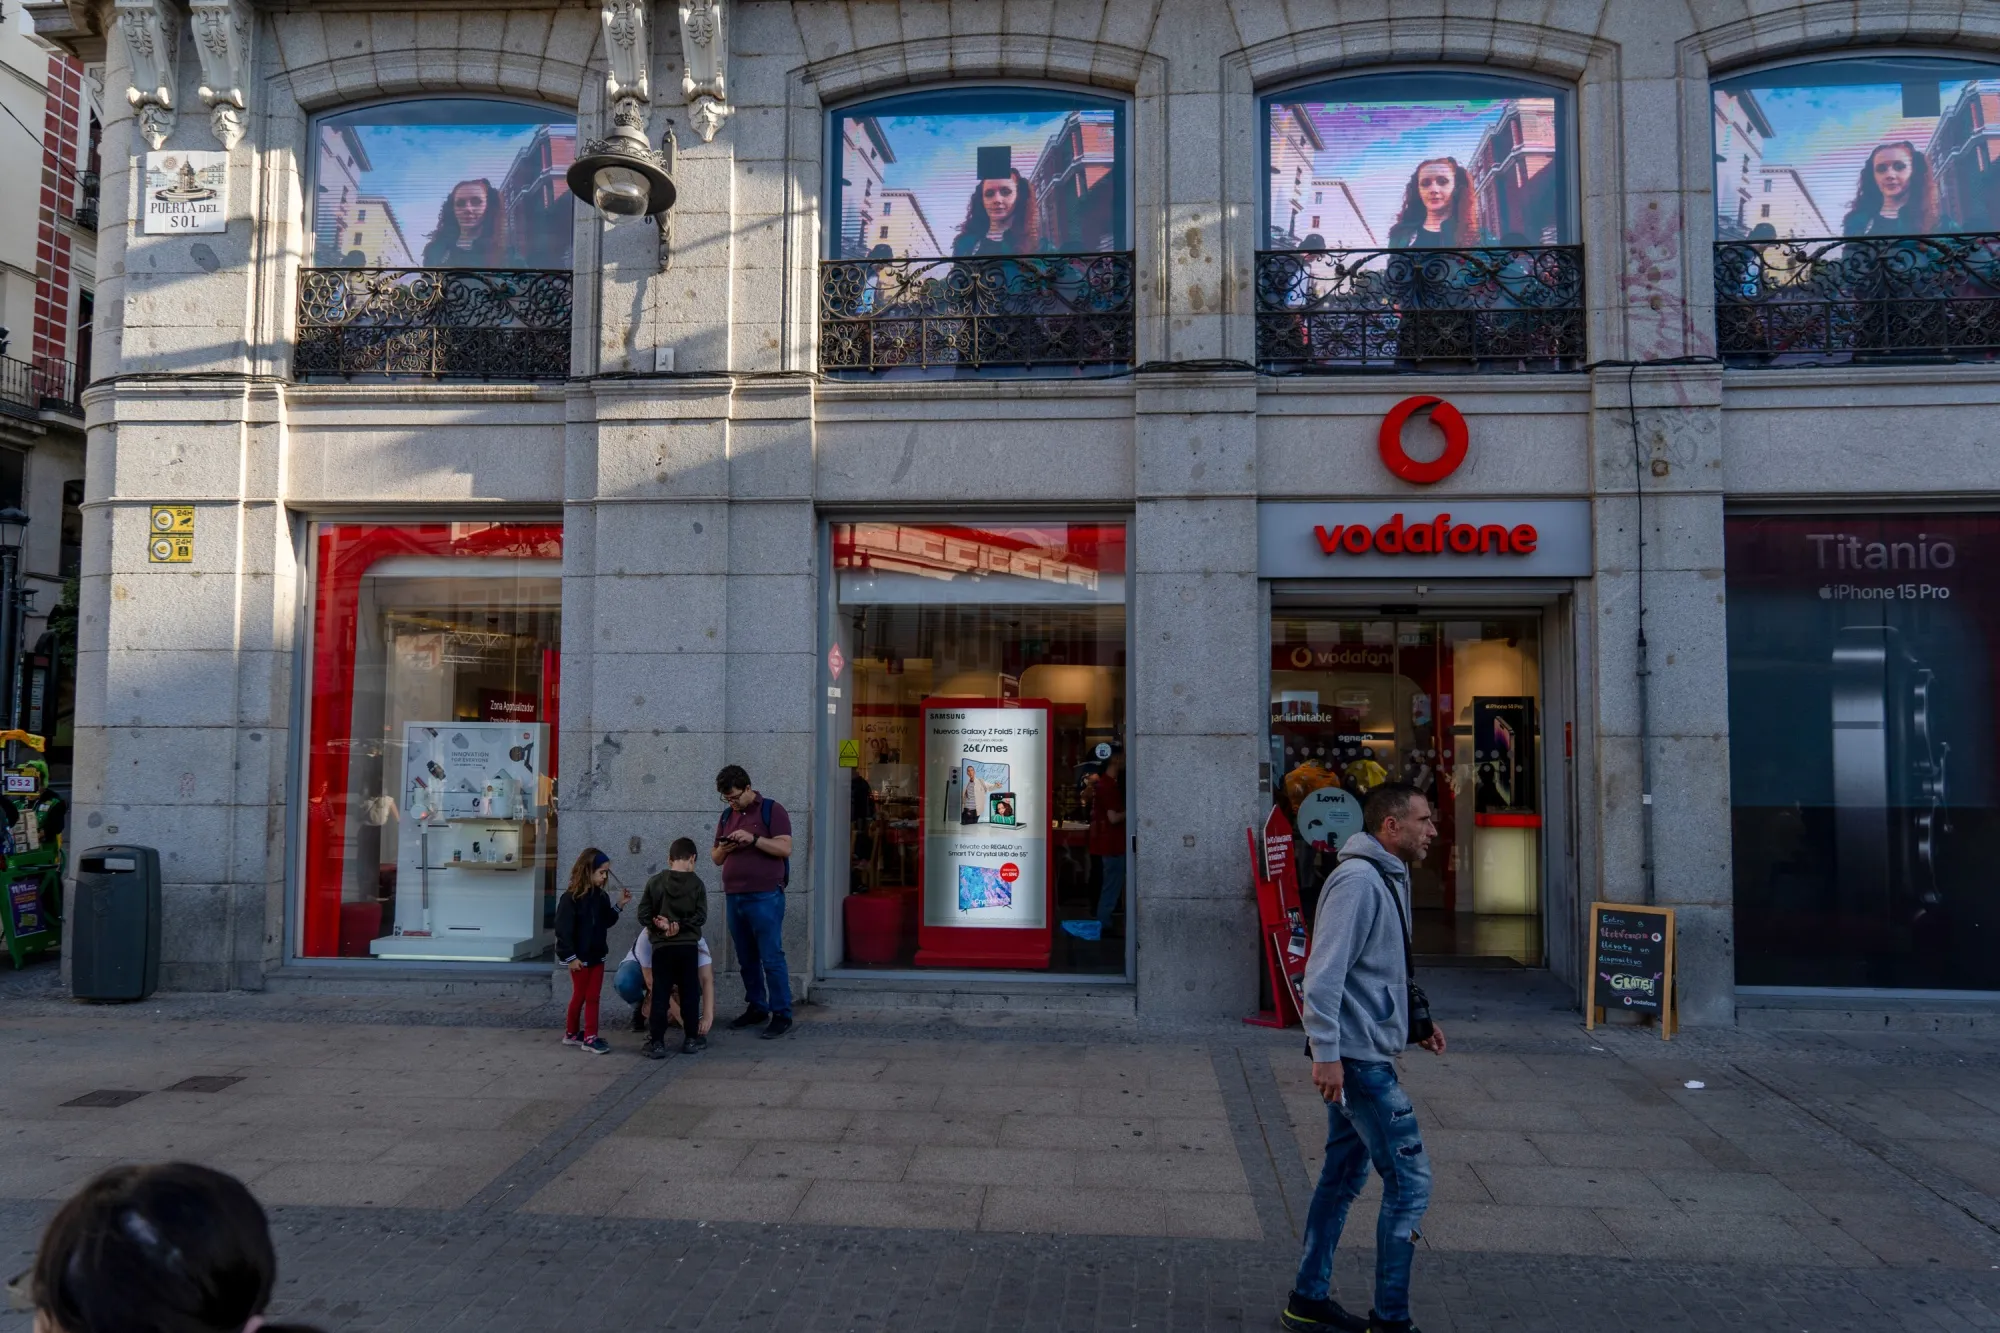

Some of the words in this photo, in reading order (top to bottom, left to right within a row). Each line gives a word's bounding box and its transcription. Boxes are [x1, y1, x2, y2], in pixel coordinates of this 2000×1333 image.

[151, 202, 197, 214] PUERTA
[198, 204, 220, 213] DEL
[170, 215, 199, 228] SOL
[1313, 513, 1538, 556] vodafone
[1806, 533, 1956, 570] Titanio
[1834, 584, 1895, 600] iPhone
[1896, 584, 1917, 600] 15
[1919, 584, 1950, 600] Pro
[490, 700, 503, 711] Zona
[961, 728, 987, 737] Galaxy
[1022, 728, 1039, 737] Flip5
[963, 744, 1008, 754] 26€/mes
[1316, 793, 1346, 804] Lowi
[976, 850, 997, 859] Crystal
[1599, 955, 1643, 966] dispositivo
